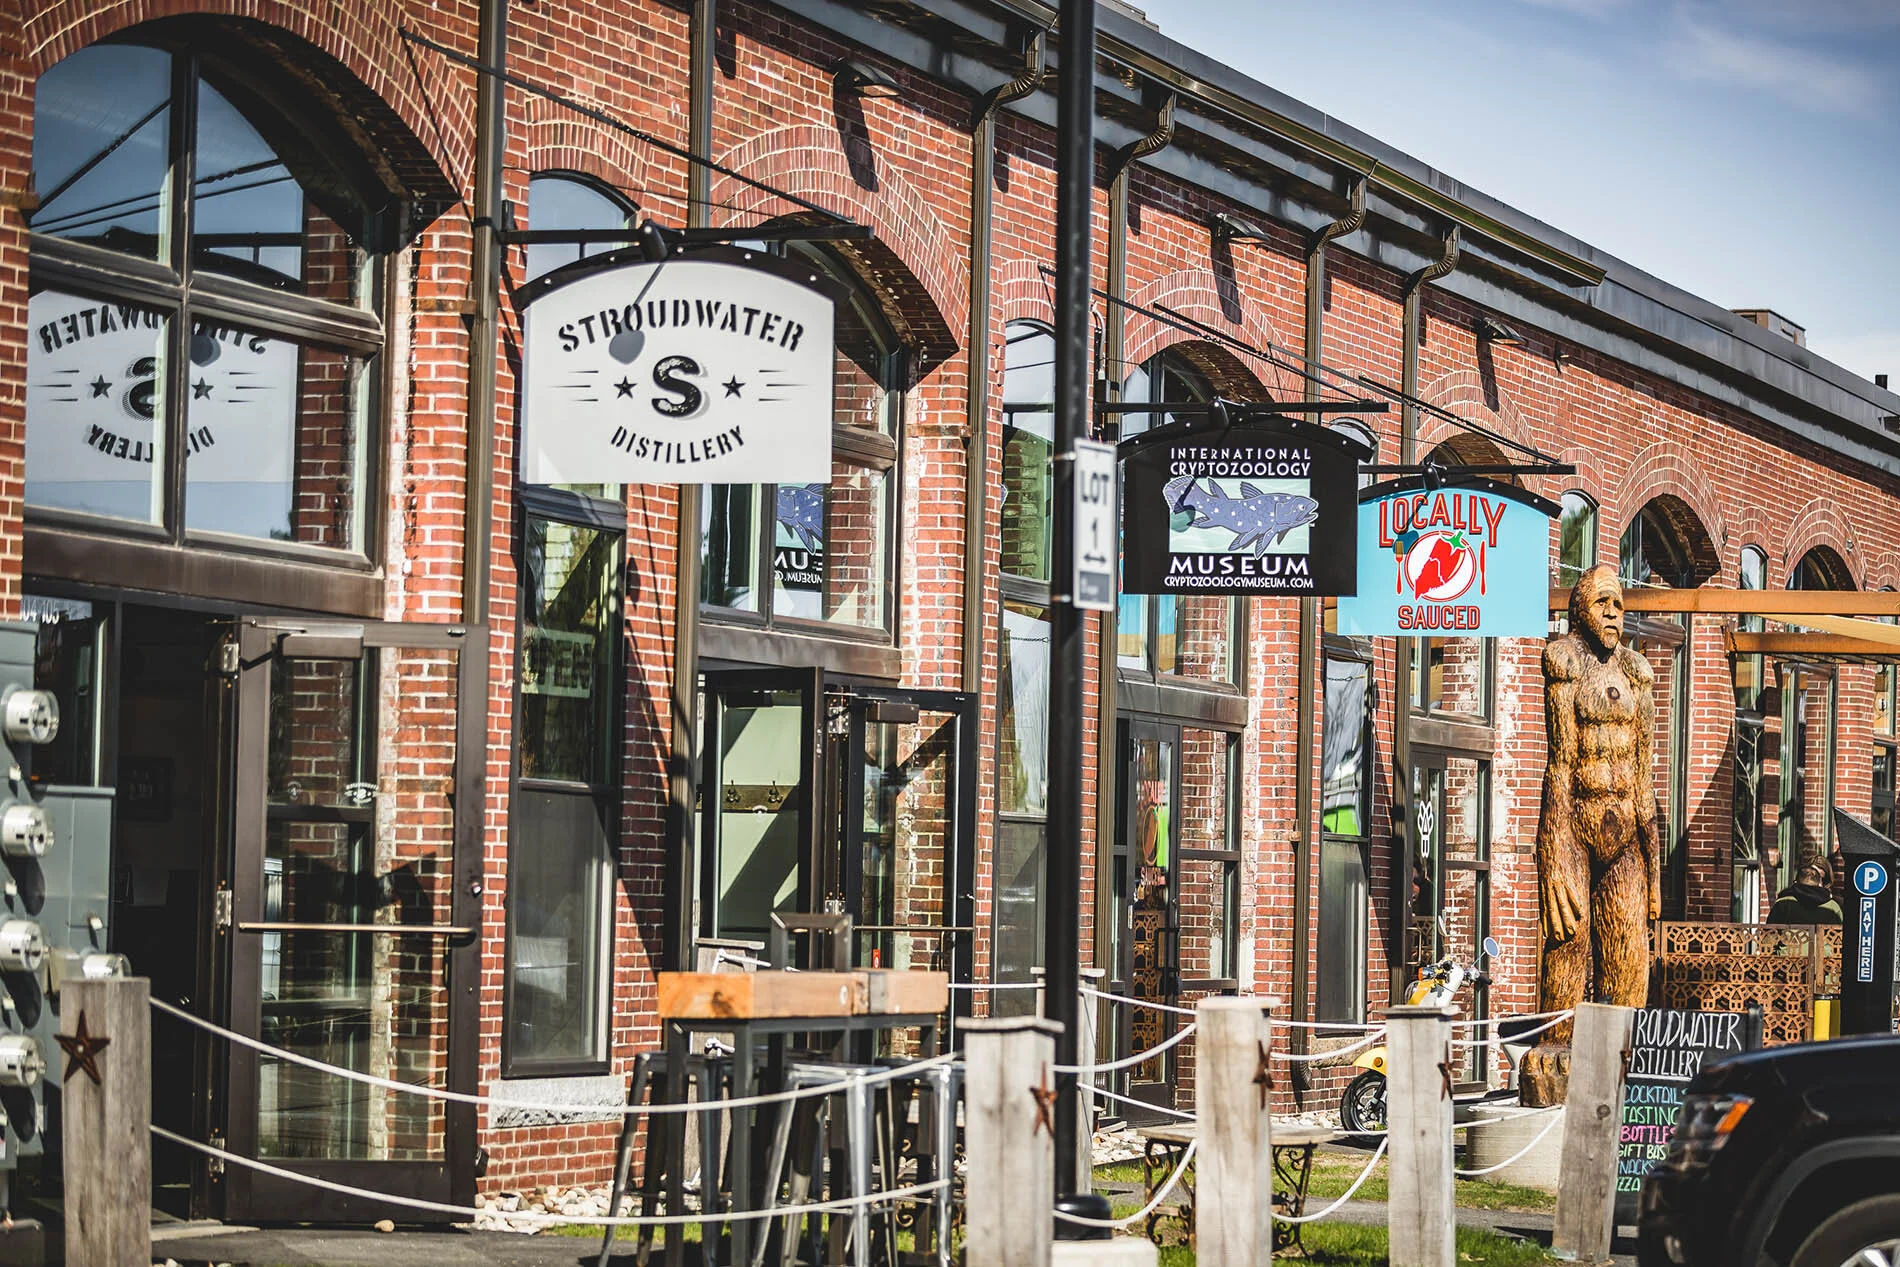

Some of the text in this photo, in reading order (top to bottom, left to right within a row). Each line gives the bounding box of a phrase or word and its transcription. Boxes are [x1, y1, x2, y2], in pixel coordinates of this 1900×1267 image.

[558, 299, 805, 352] STROUDWATER
[651, 355, 706, 419] S
[610, 425, 745, 464] DISTILLERY
[1170, 448, 1312, 460] INTERNATIONAL
[1170, 461, 1312, 477] CRYPTOZOOLOGY
[1079, 470, 1110, 507] LOT
[1378, 492, 1508, 548] LOCALLY
[1169, 555, 1309, 576] MUSEUM
[1164, 576, 1314, 589] CRYPTOZOOLOGYMUSEUM.COM
[1397, 604, 1481, 630] SAUCED
[1863, 867, 1879, 891] P
[1860, 902, 1873, 979] PAY HERE
[1634, 1008, 1742, 1051] ROUDWATER
[1630, 1047, 1704, 1077] ISTILLERY
